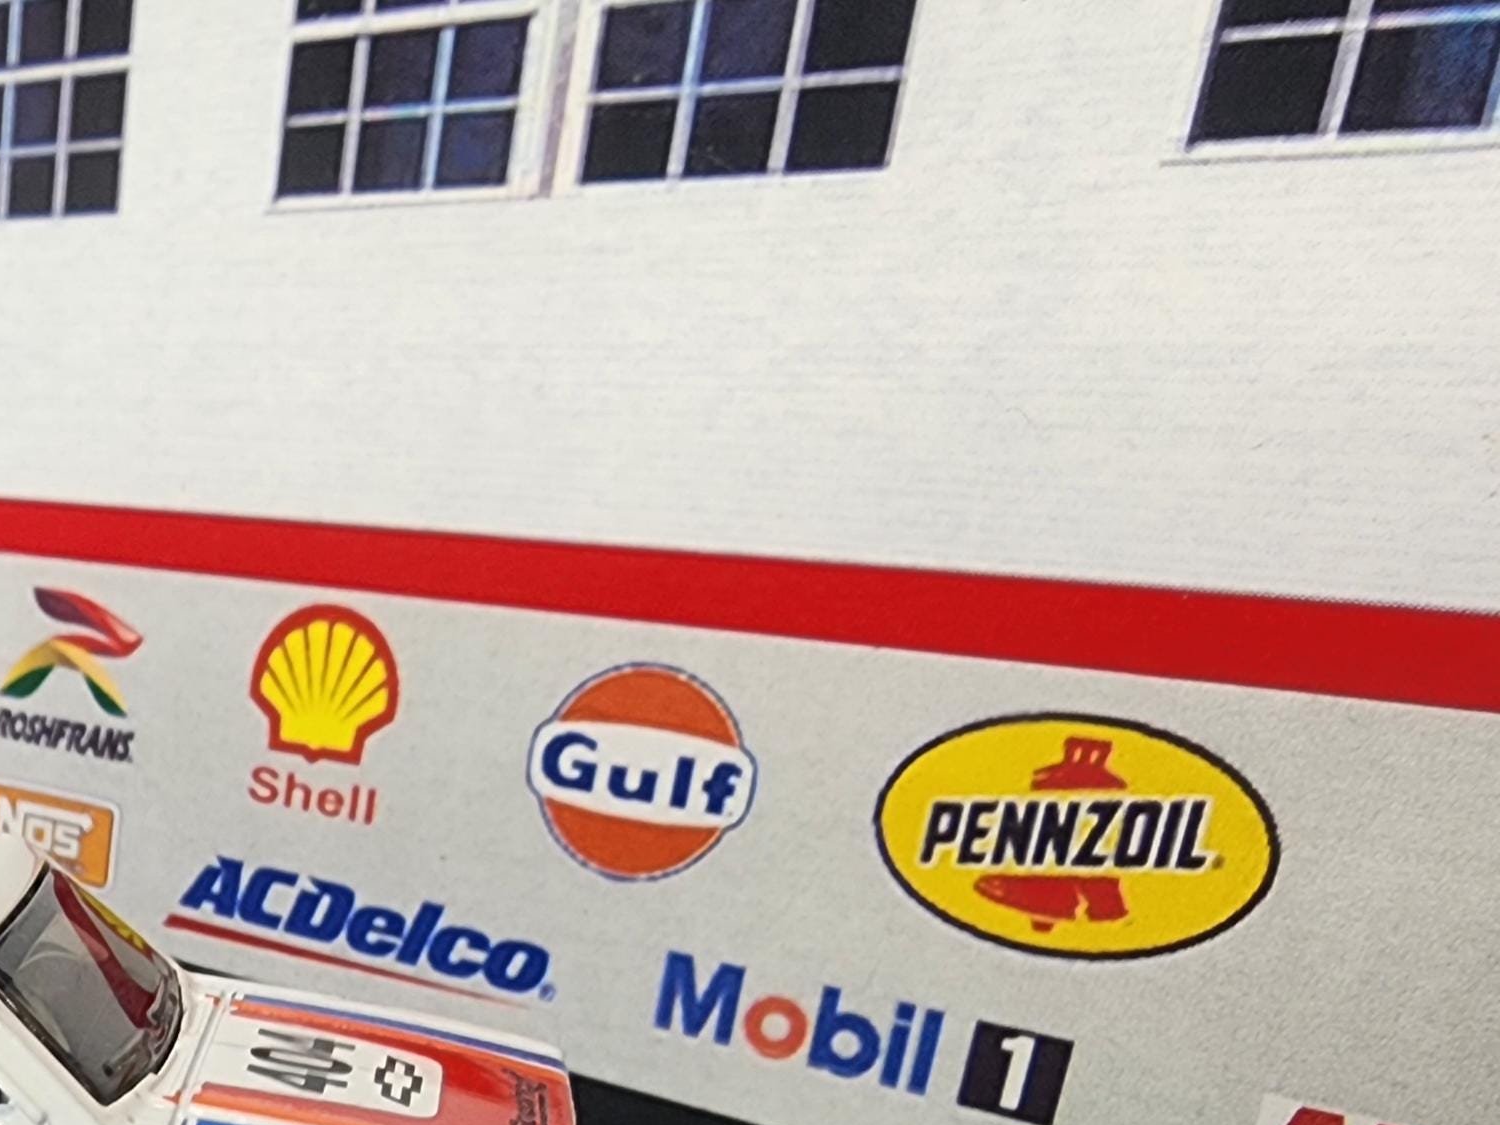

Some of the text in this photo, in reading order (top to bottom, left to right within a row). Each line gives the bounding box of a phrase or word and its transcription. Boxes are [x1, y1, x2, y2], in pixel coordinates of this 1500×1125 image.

[248, 766, 377, 825] Shell
[541, 731, 742, 816] Gulf
[920, 800, 1207, 868] PENNZOIL
[180, 855, 550, 994] ACDelco
[654, 950, 1037, 1112] Mobil 1
